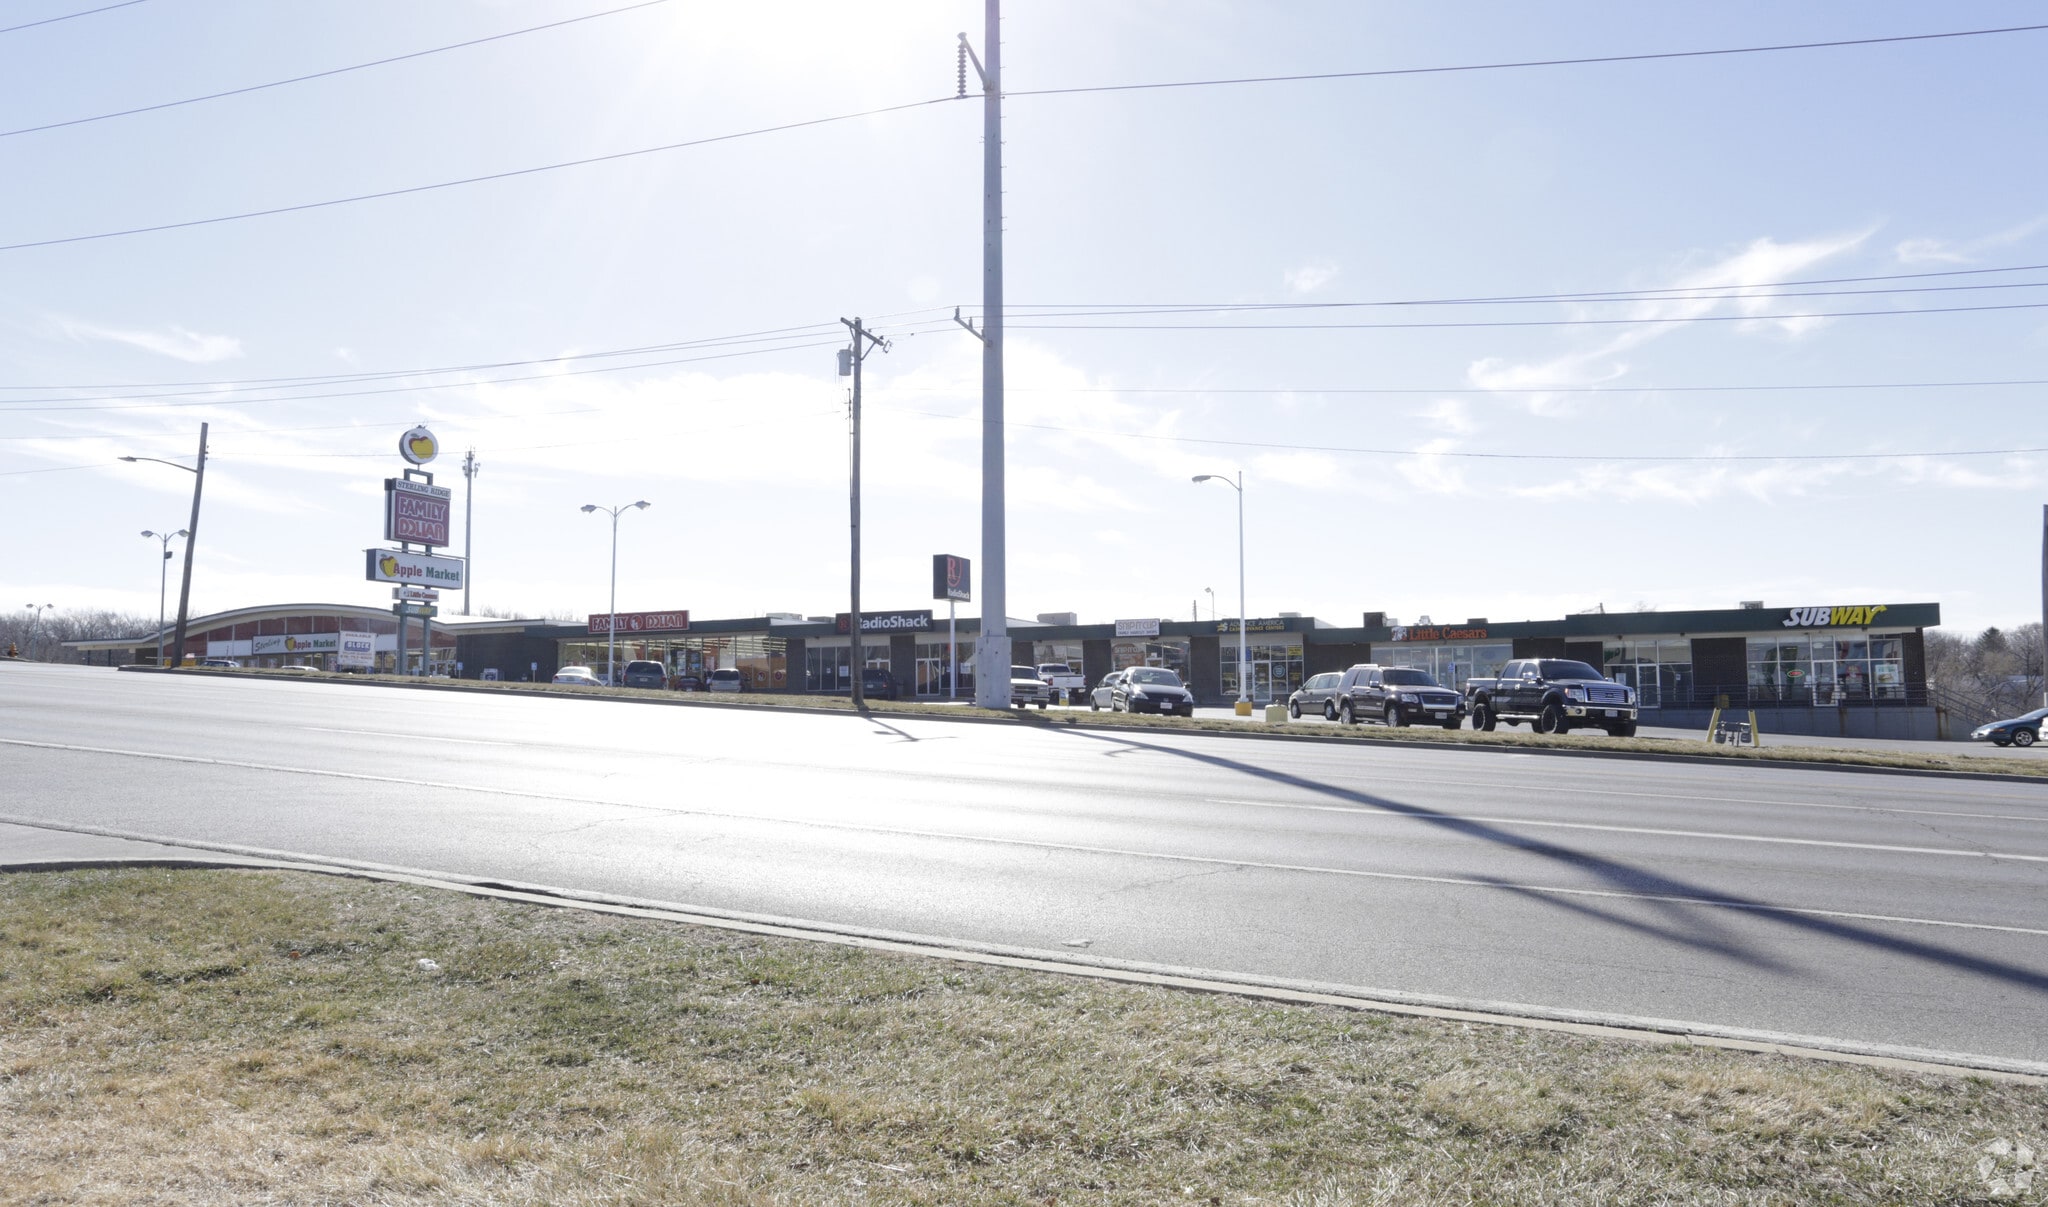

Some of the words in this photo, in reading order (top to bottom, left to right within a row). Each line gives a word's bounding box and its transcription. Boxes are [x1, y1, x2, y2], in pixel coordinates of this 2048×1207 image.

[397, 481, 429, 494] STERLING
[430, 486, 449, 497] RIDGE
[399, 497, 446, 520] FAMILY
[399, 517, 444, 540] DOLLAR
[393, 563, 422, 577] Apple
[425, 566, 460, 581] Market
[645, 614, 683, 629] DOLLAR
[1782, 604, 1888, 627] SUBWAY
[1409, 627, 1439, 640] Little
[1441, 626, 1487, 639] Caesars
[293, 640, 312, 650] Apple
[313, 639, 336, 648] Market
[347, 641, 370, 649] BLOCK
